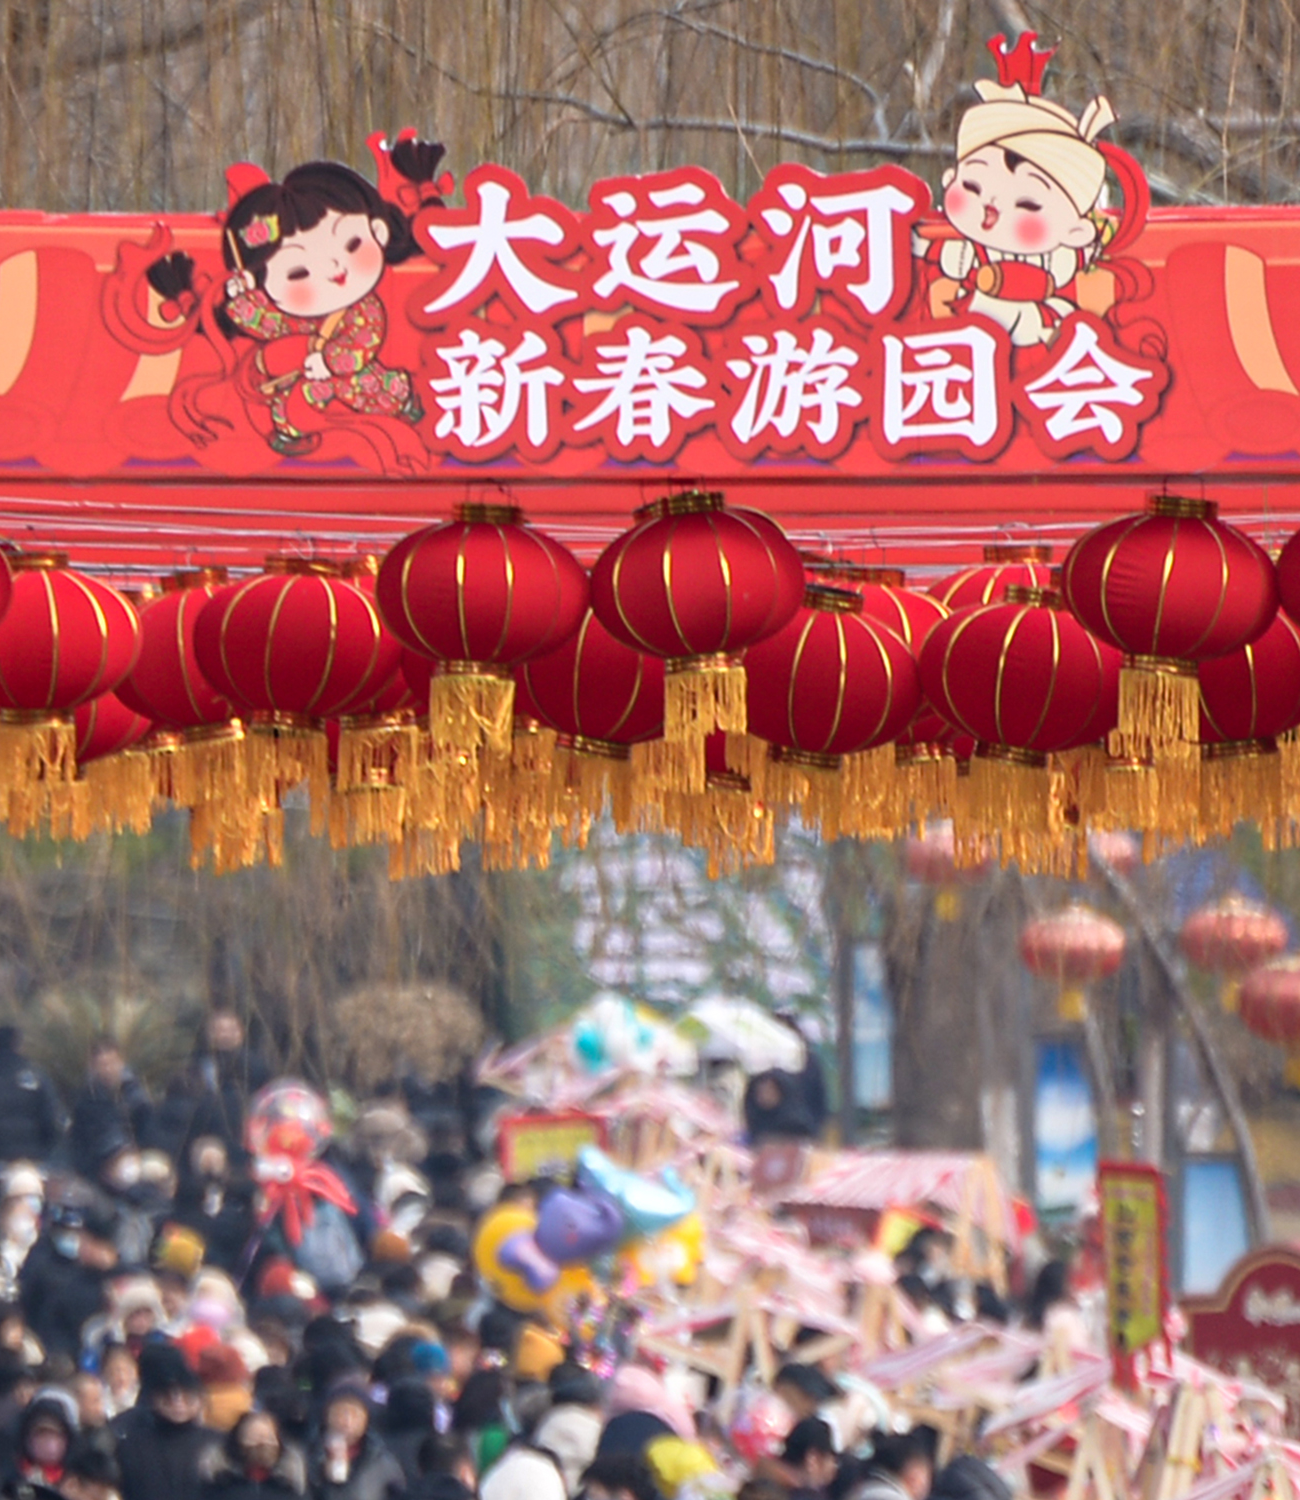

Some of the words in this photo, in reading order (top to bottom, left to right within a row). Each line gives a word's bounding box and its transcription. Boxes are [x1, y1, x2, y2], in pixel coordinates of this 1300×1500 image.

[425, 182, 914, 313] 大运河
[430, 322, 1152, 446] 新春游园会
